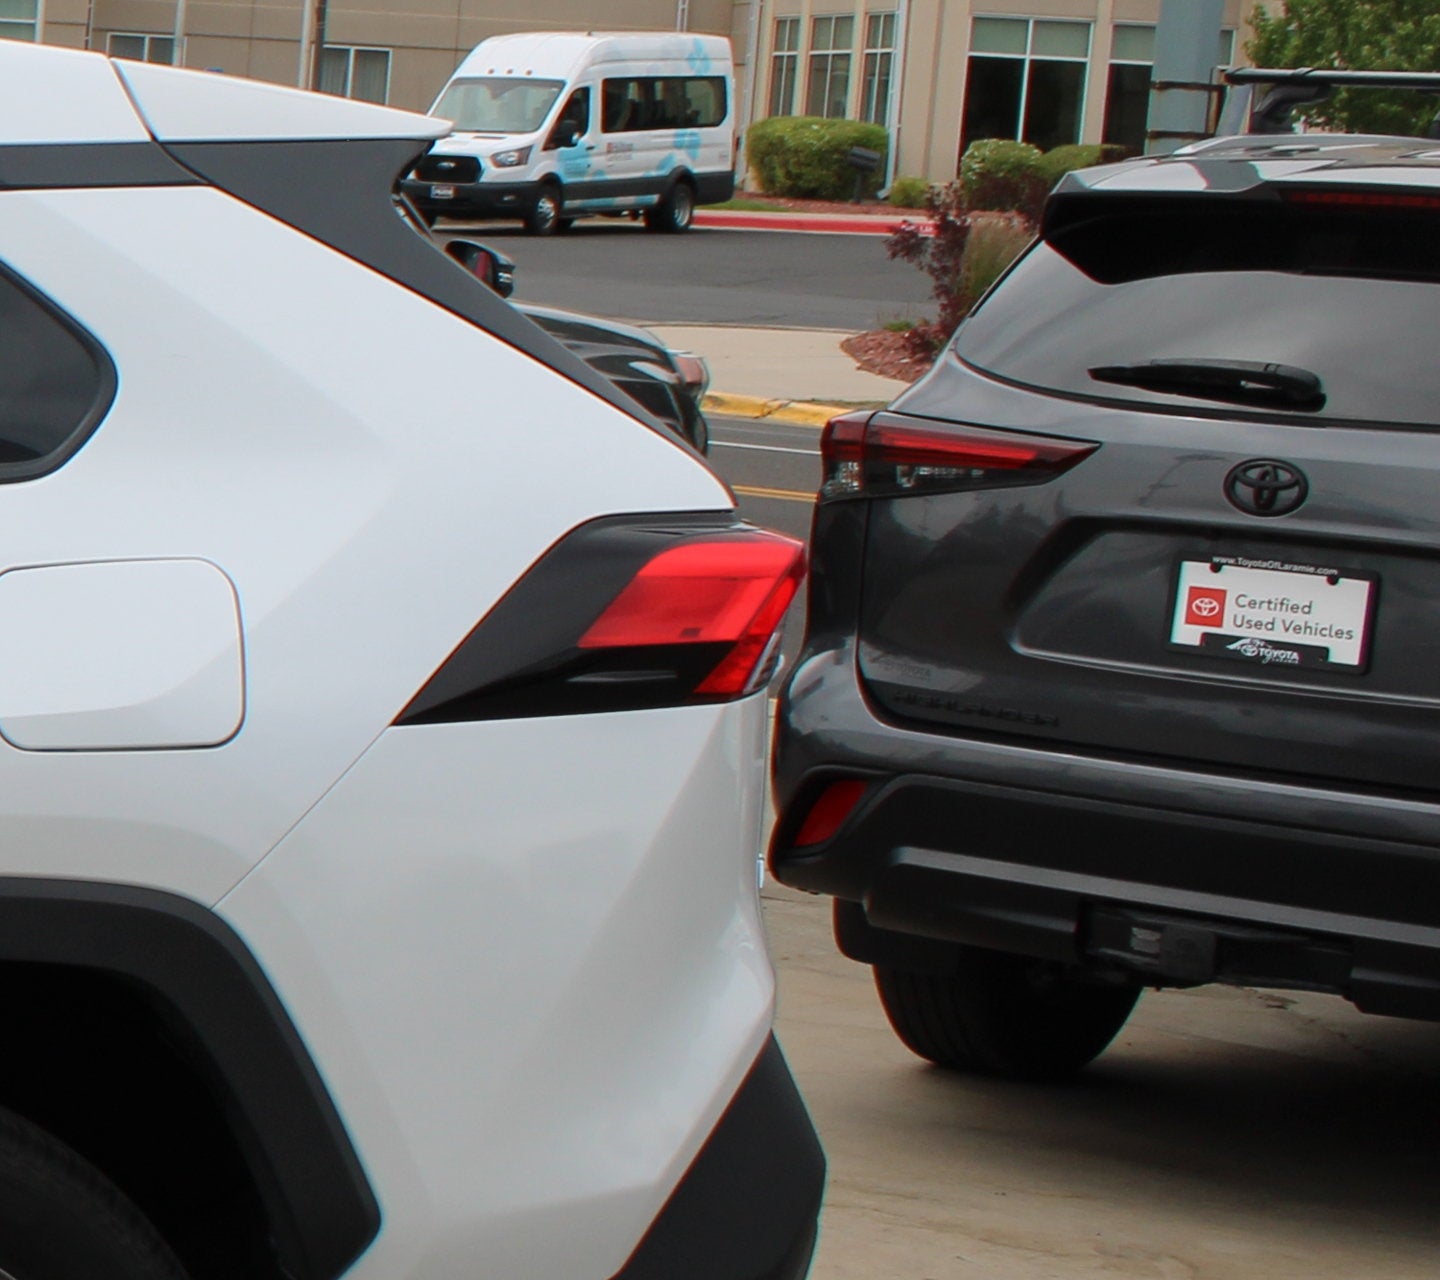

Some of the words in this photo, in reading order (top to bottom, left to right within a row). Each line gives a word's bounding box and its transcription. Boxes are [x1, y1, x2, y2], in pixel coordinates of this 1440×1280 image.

[1235, 593, 1312, 614] Certified
[1232, 614, 1276, 632] Used
[1282, 620, 1354, 640] Vehicles
[1259, 647, 1299, 660] TOYOTA
